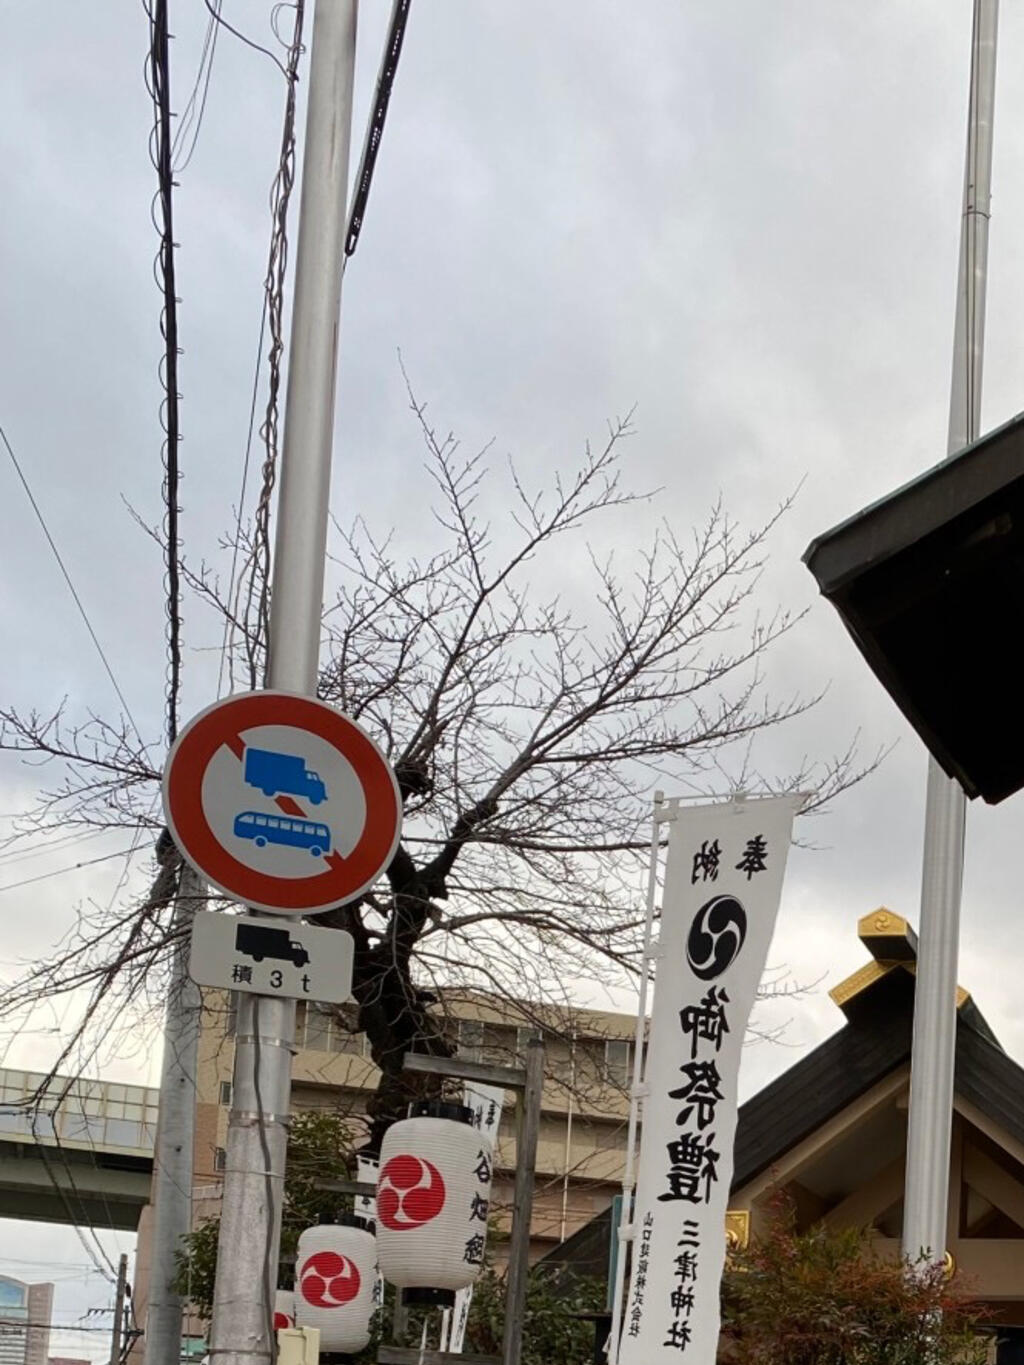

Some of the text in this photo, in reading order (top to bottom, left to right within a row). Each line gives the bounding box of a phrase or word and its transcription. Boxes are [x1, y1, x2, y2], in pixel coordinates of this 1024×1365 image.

[231, 963, 312, 993] 積 3 t
